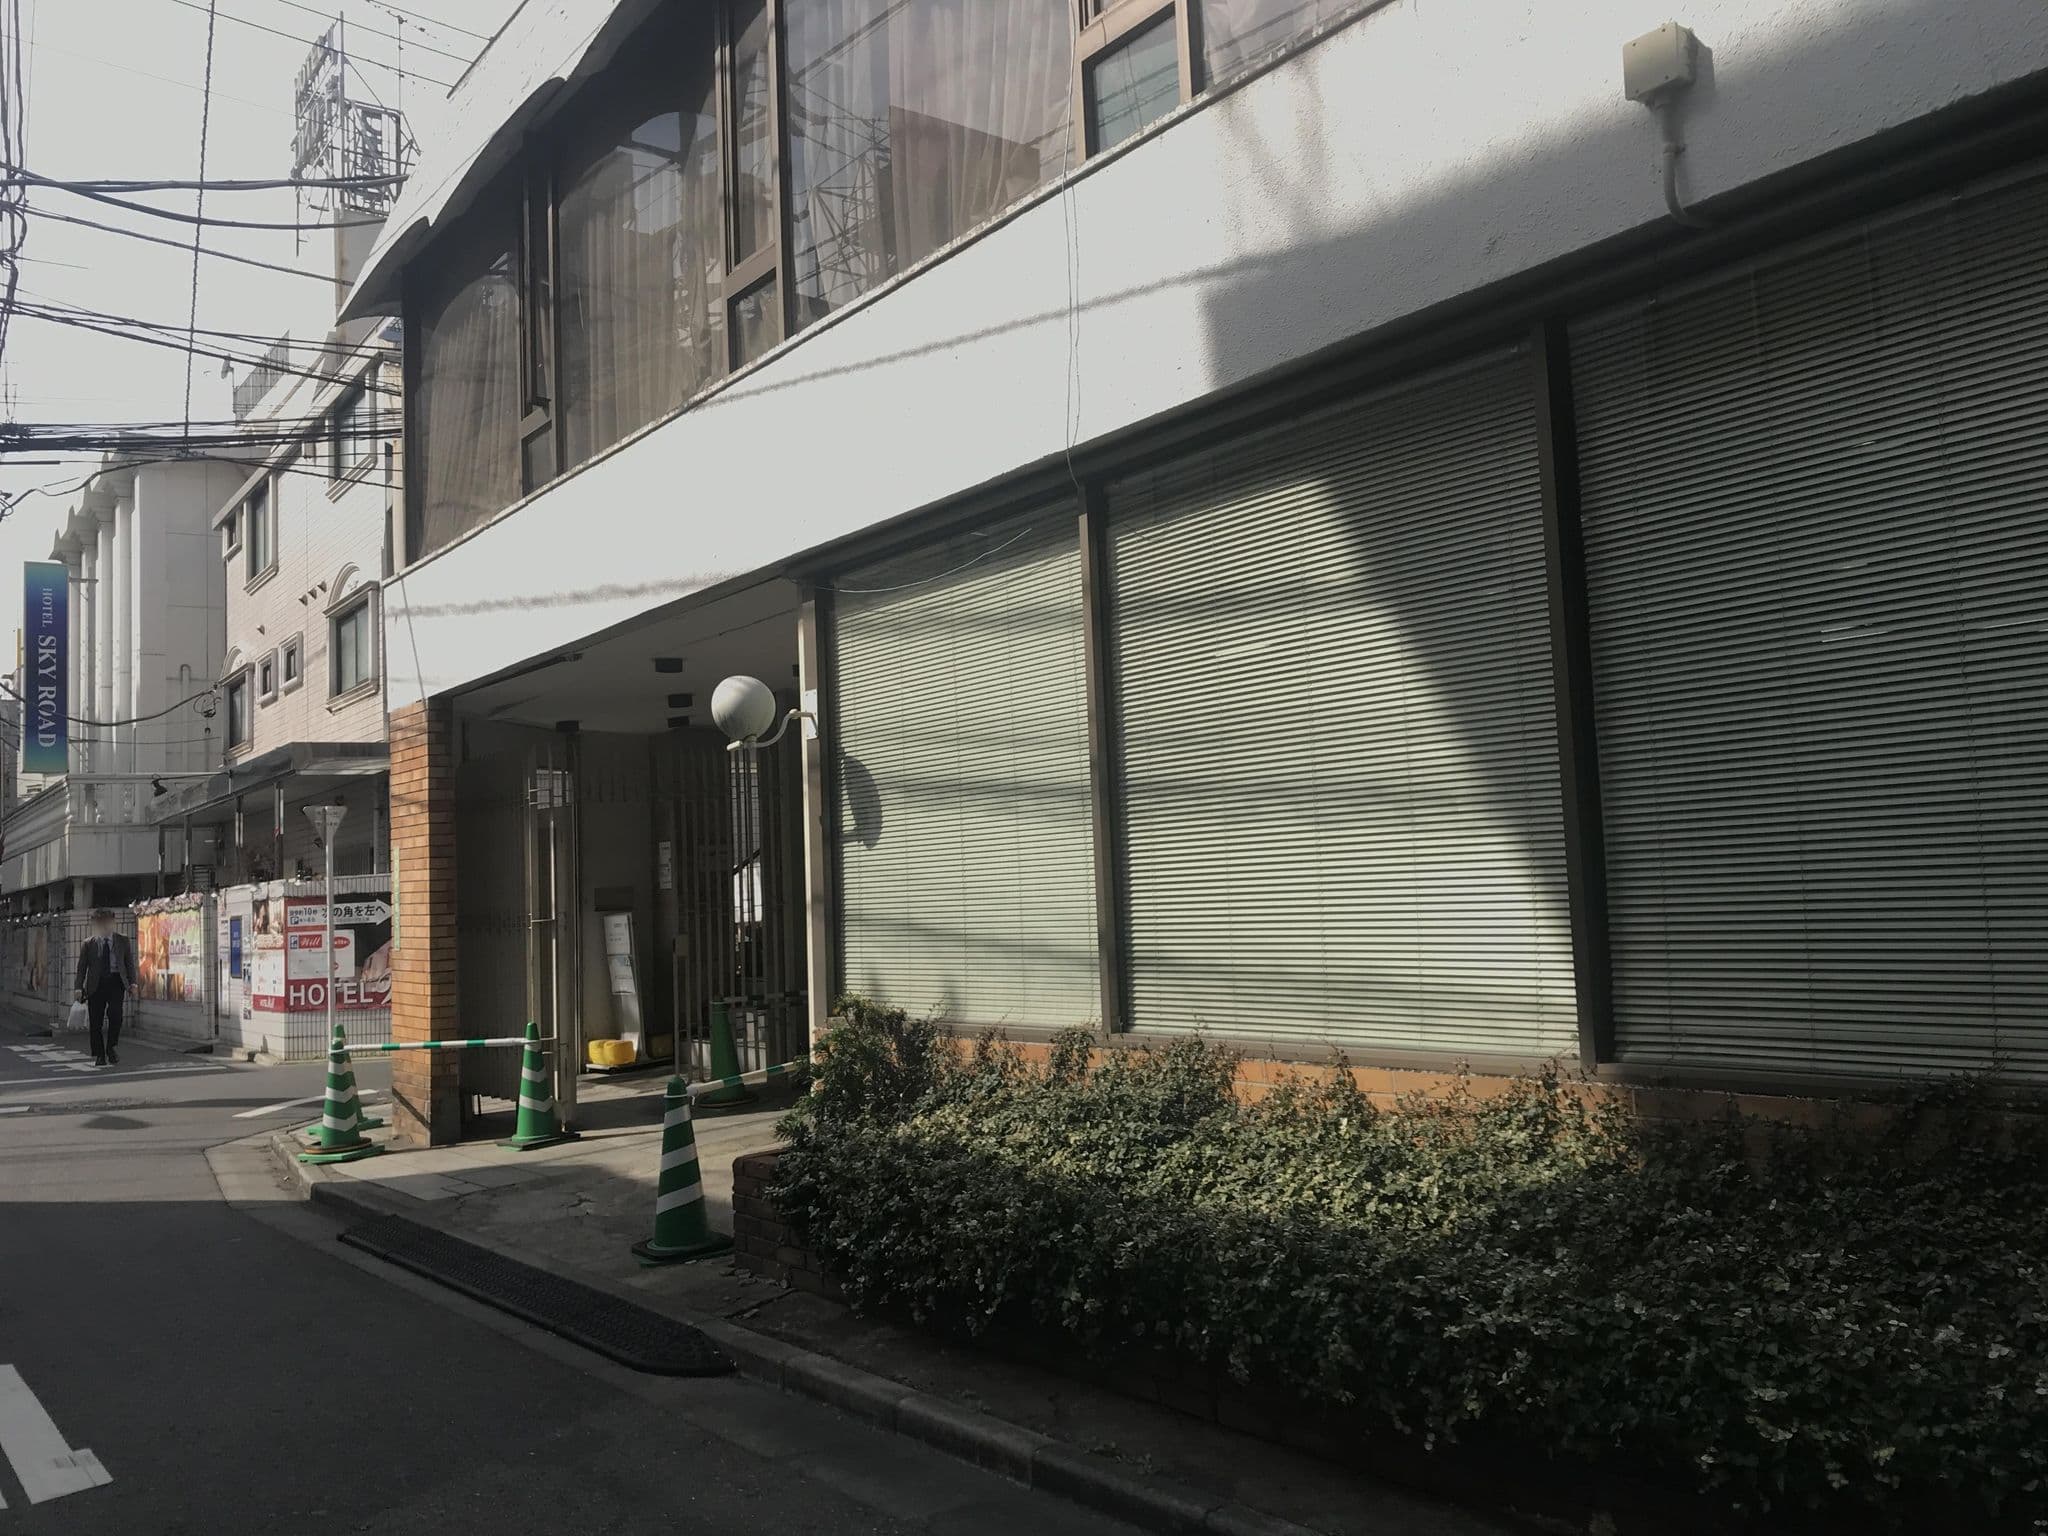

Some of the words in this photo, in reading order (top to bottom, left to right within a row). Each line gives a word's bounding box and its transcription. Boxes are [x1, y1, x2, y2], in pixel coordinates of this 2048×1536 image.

[42, 587, 53, 627] HOTEL
[37, 634, 57, 683] SKY
[37, 684, 57, 748] ROAD
